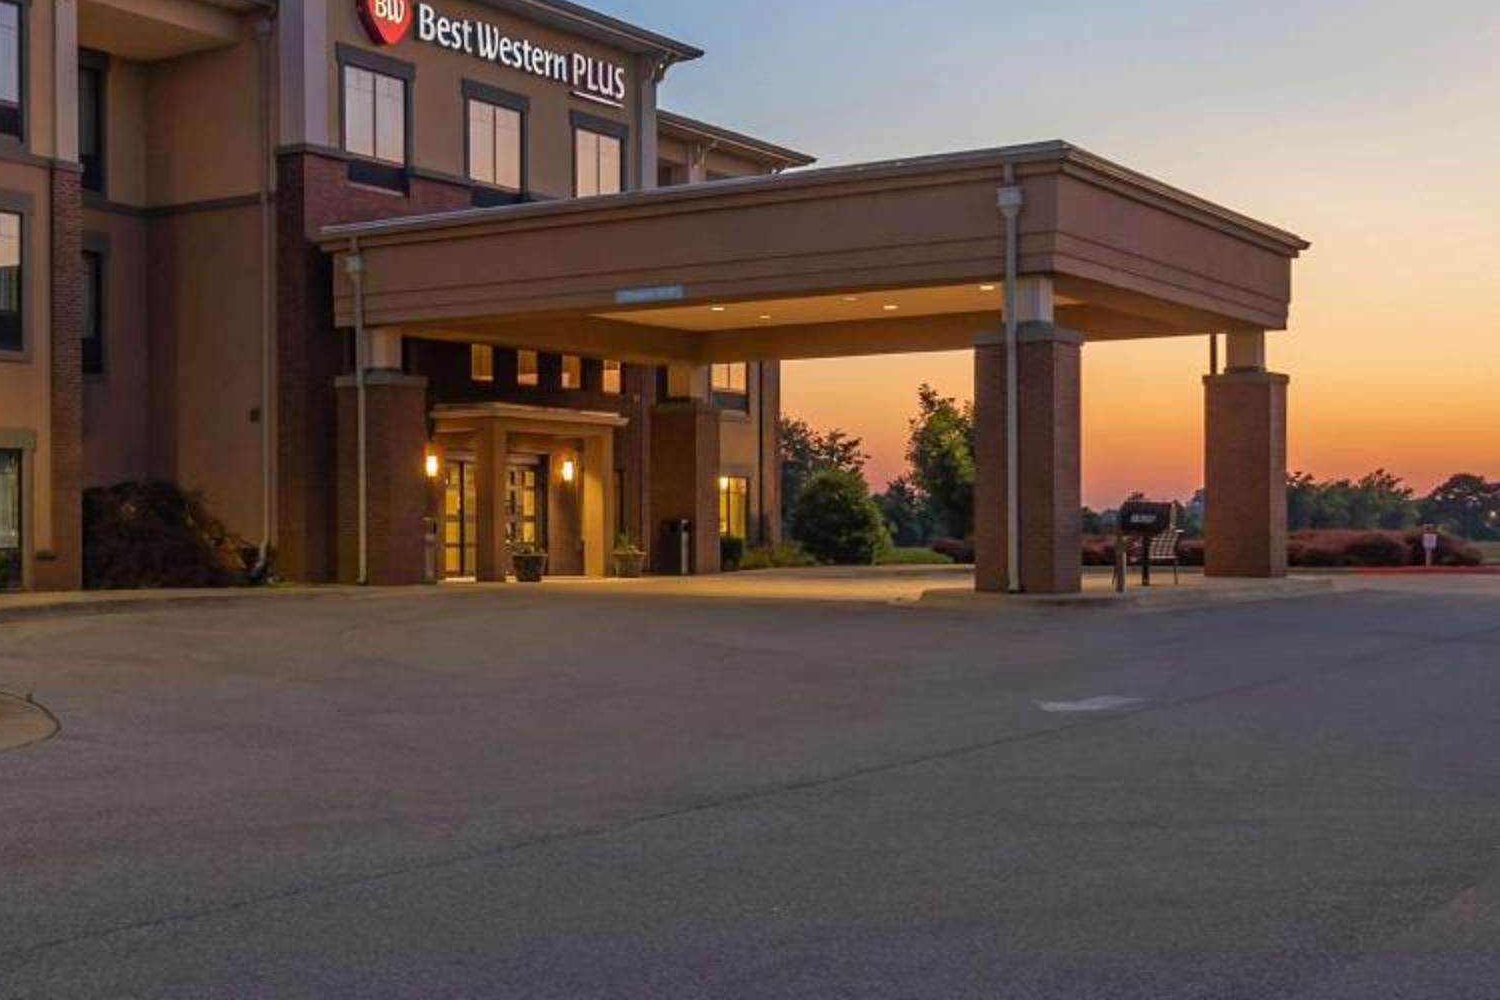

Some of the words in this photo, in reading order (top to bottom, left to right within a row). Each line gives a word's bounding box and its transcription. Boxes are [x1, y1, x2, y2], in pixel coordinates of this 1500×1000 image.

[418, 3, 473, 53] Best
[477, 24, 568, 81] Western
[572, 53, 625, 99] PLUS
